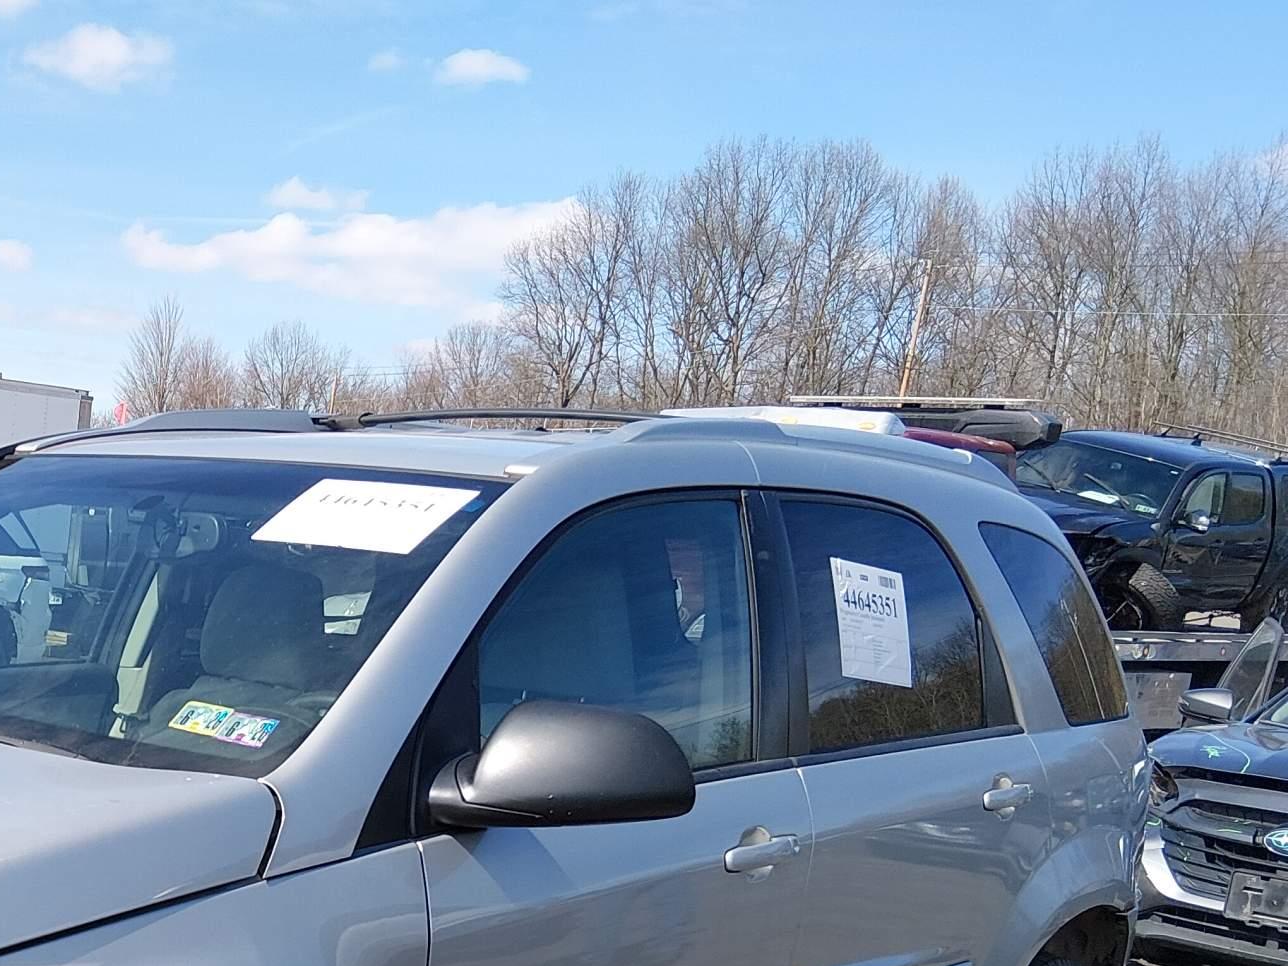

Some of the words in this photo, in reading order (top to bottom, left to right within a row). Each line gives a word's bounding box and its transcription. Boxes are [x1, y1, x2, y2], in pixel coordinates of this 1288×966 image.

[844, 587, 898, 618] 44645351
[179, 710, 195, 725] 6
[225, 721, 241, 737] 6
